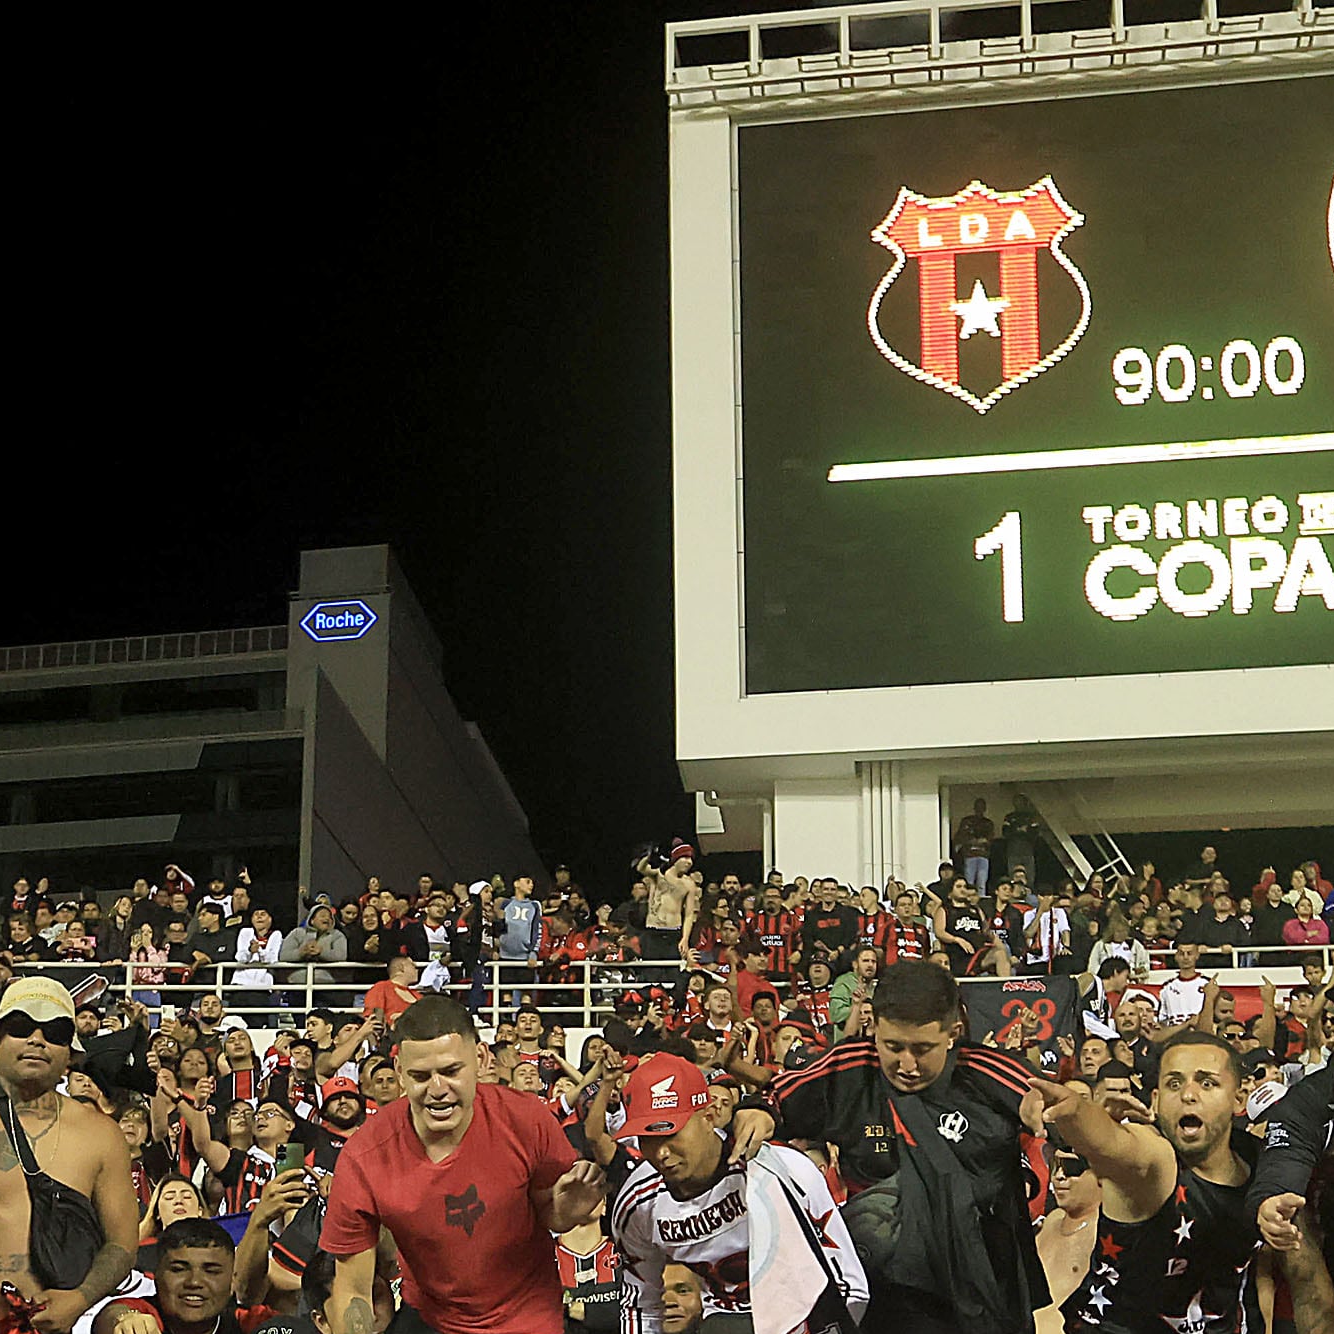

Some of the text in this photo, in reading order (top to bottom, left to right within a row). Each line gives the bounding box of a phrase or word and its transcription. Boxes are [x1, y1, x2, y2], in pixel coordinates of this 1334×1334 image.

[917, 209, 1037, 248] LDA
[1112, 335, 1306, 406] 90:00
[1081, 494, 1289, 544] TORNEO
[973, 510, 1025, 623] 1
[315, 610, 365, 630] Roche
[691, 1092, 709, 1107] FOX
[874, 1142, 889, 1153] 12
[1164, 1257, 1189, 1277] 12
